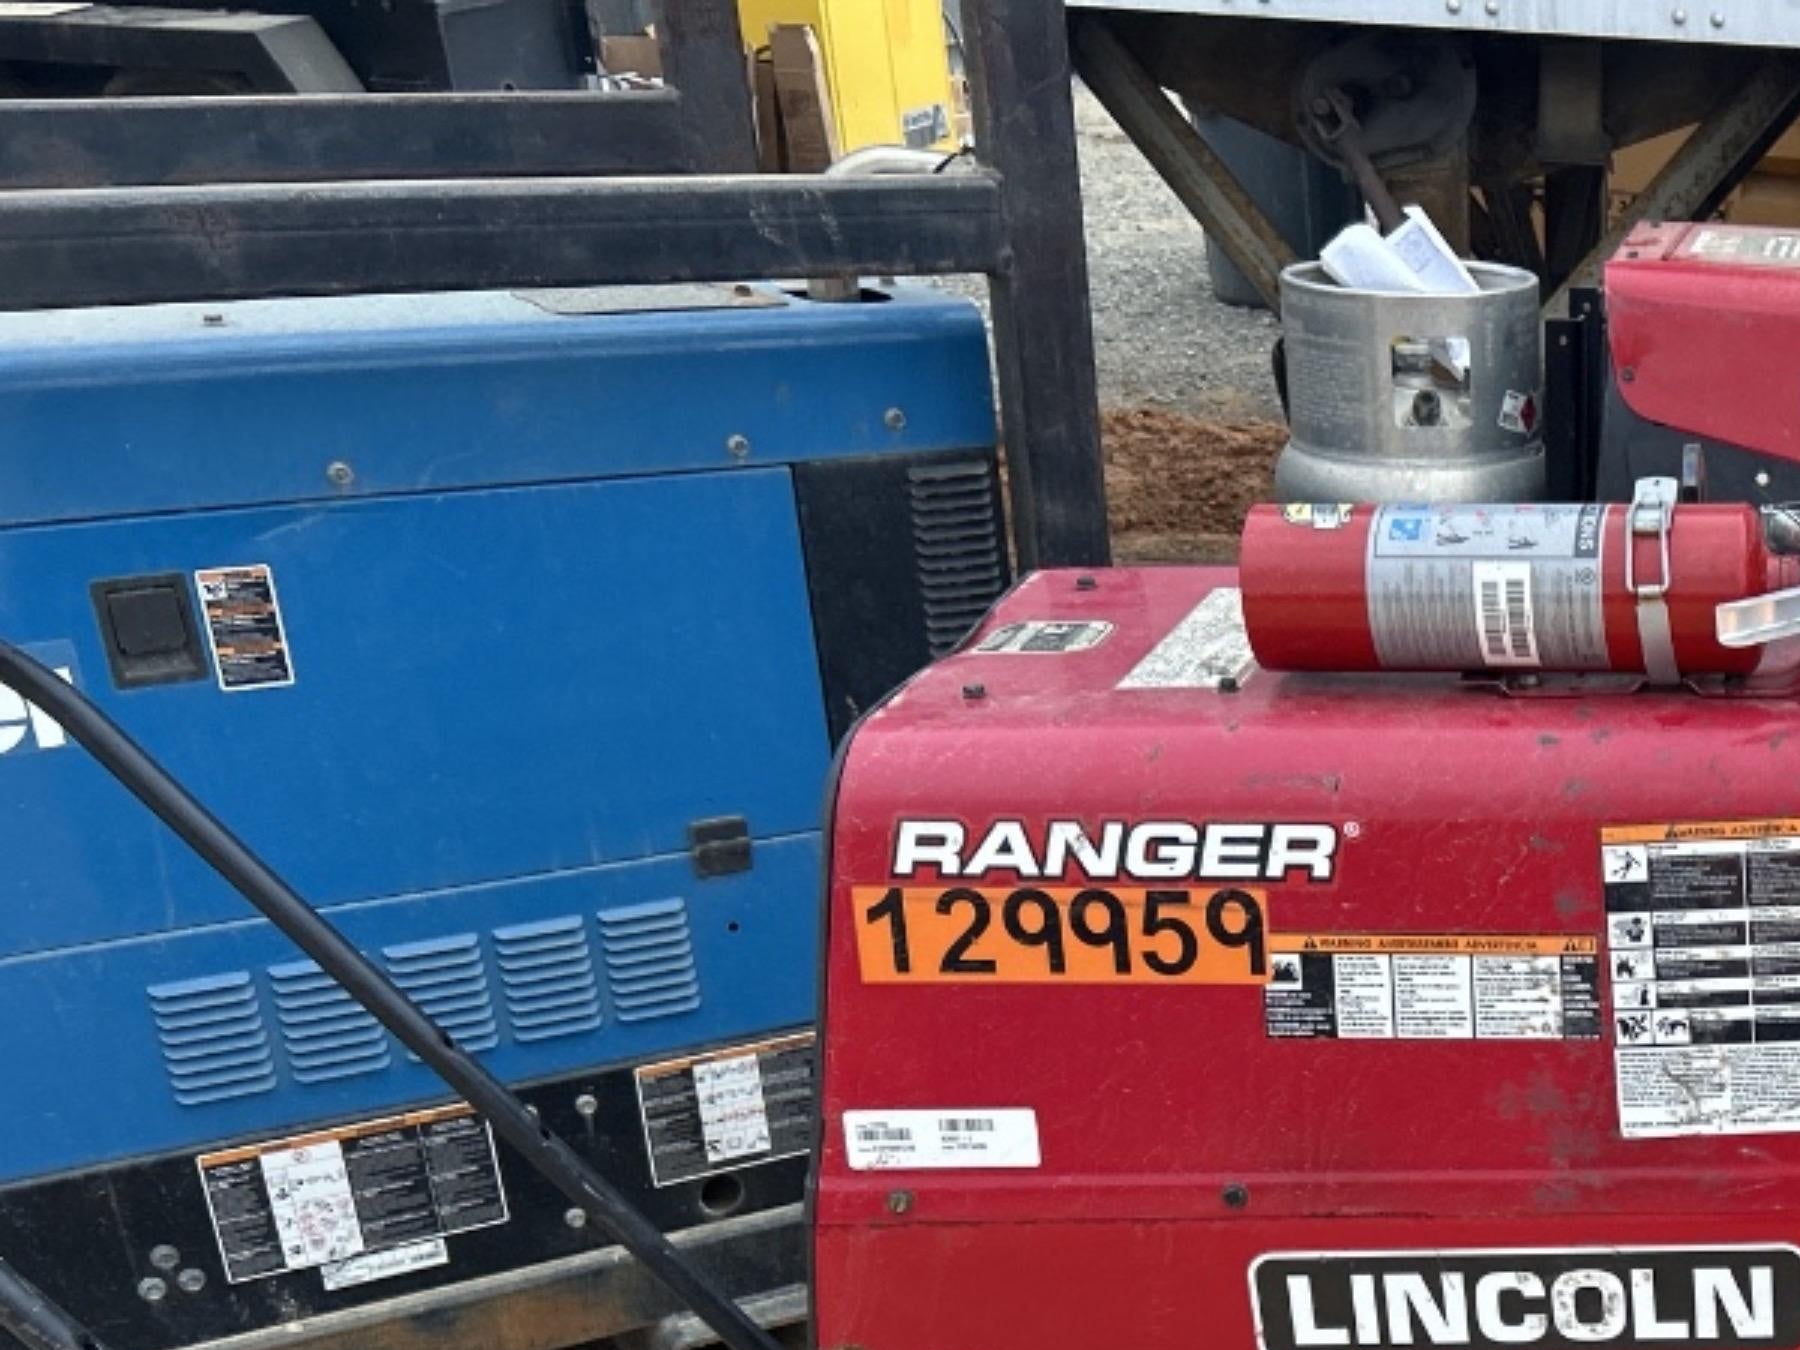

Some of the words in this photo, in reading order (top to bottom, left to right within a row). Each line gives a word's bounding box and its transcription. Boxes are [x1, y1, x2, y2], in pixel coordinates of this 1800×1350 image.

[893, 820, 1337, 879] RANGER
[866, 887, 1268, 976] 129959
[1286, 1267, 1776, 1346] LINCOLN
